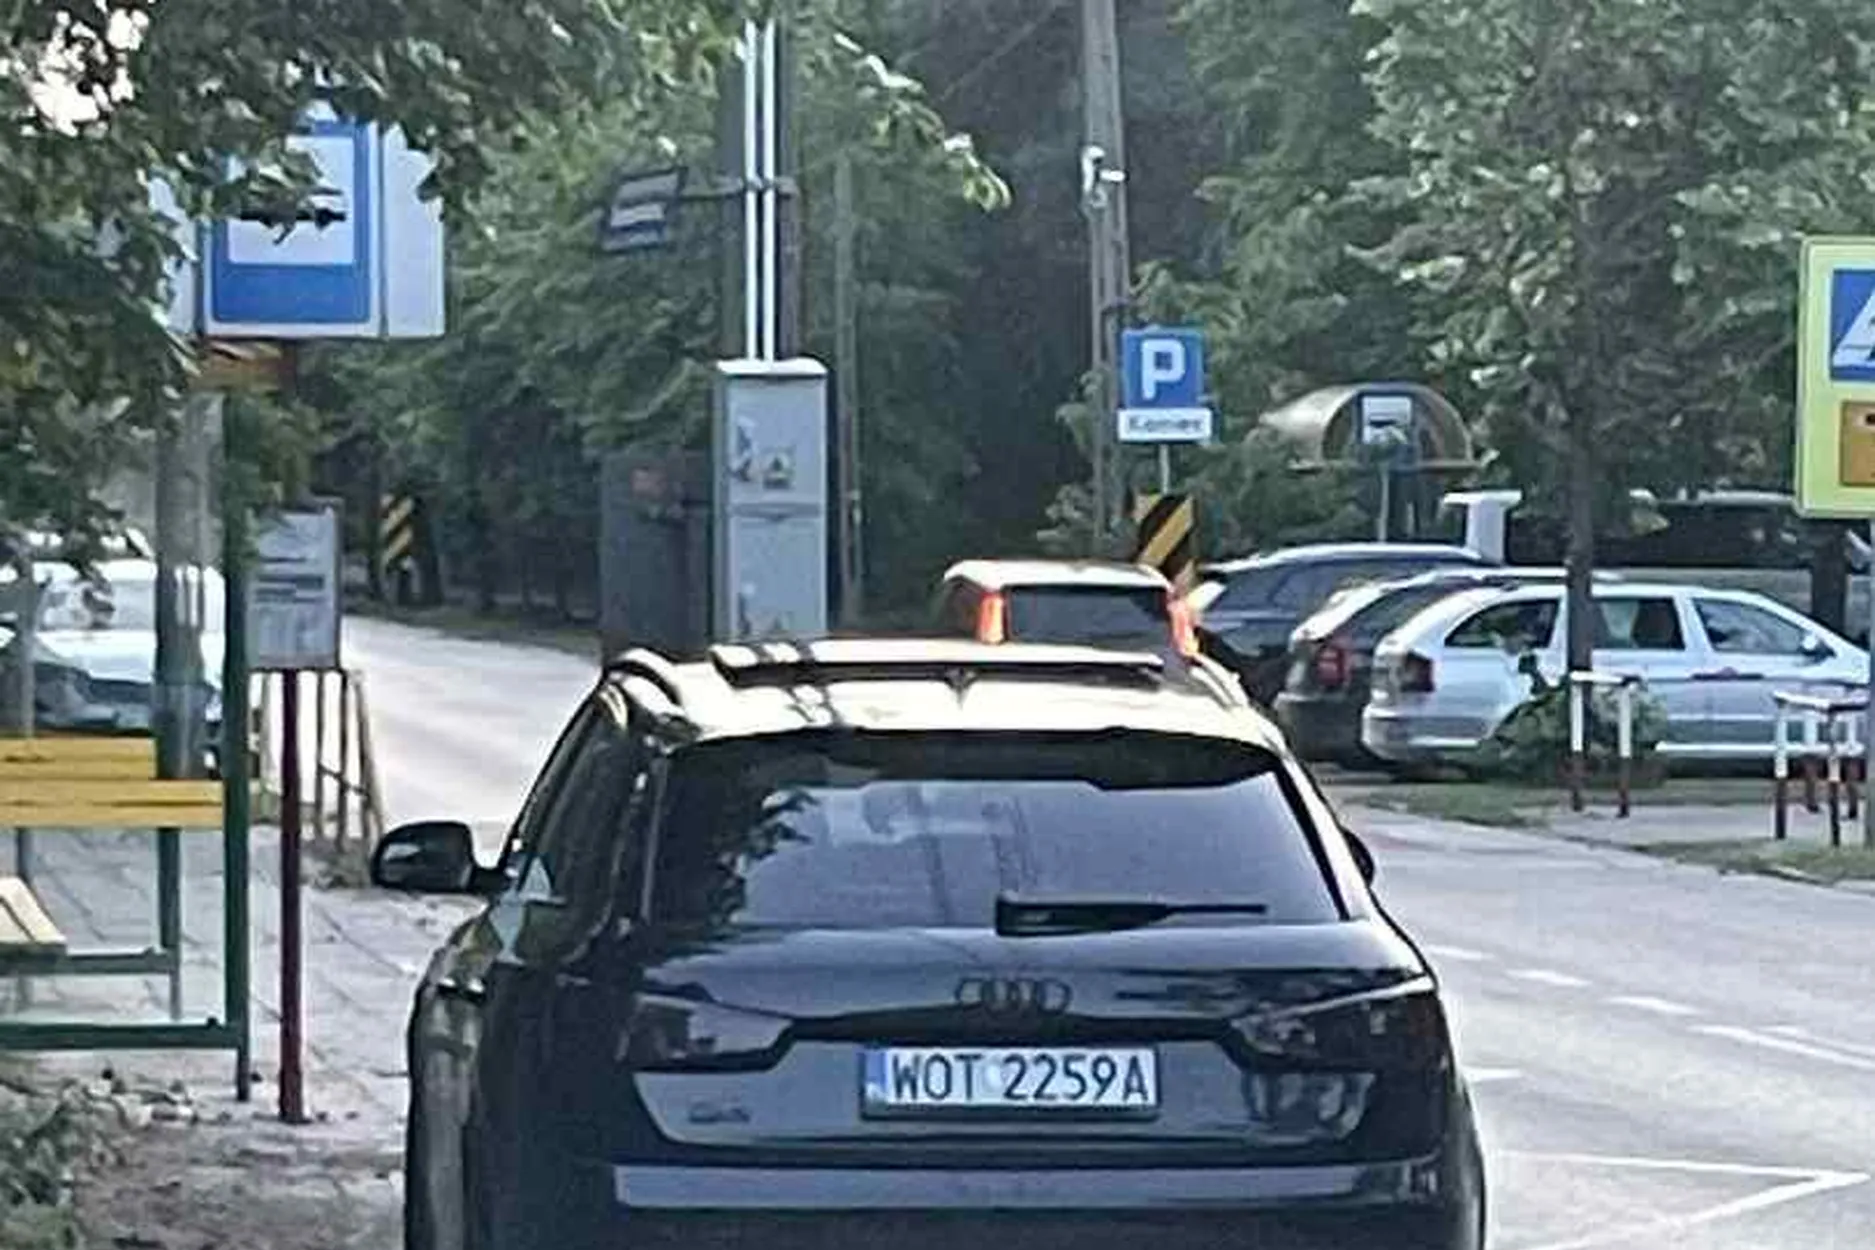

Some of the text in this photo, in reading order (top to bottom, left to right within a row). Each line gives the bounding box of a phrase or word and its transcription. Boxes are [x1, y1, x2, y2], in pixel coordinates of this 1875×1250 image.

[1142, 340, 1185, 400] P
[892, 1053, 1149, 1101] WOT 2259A
